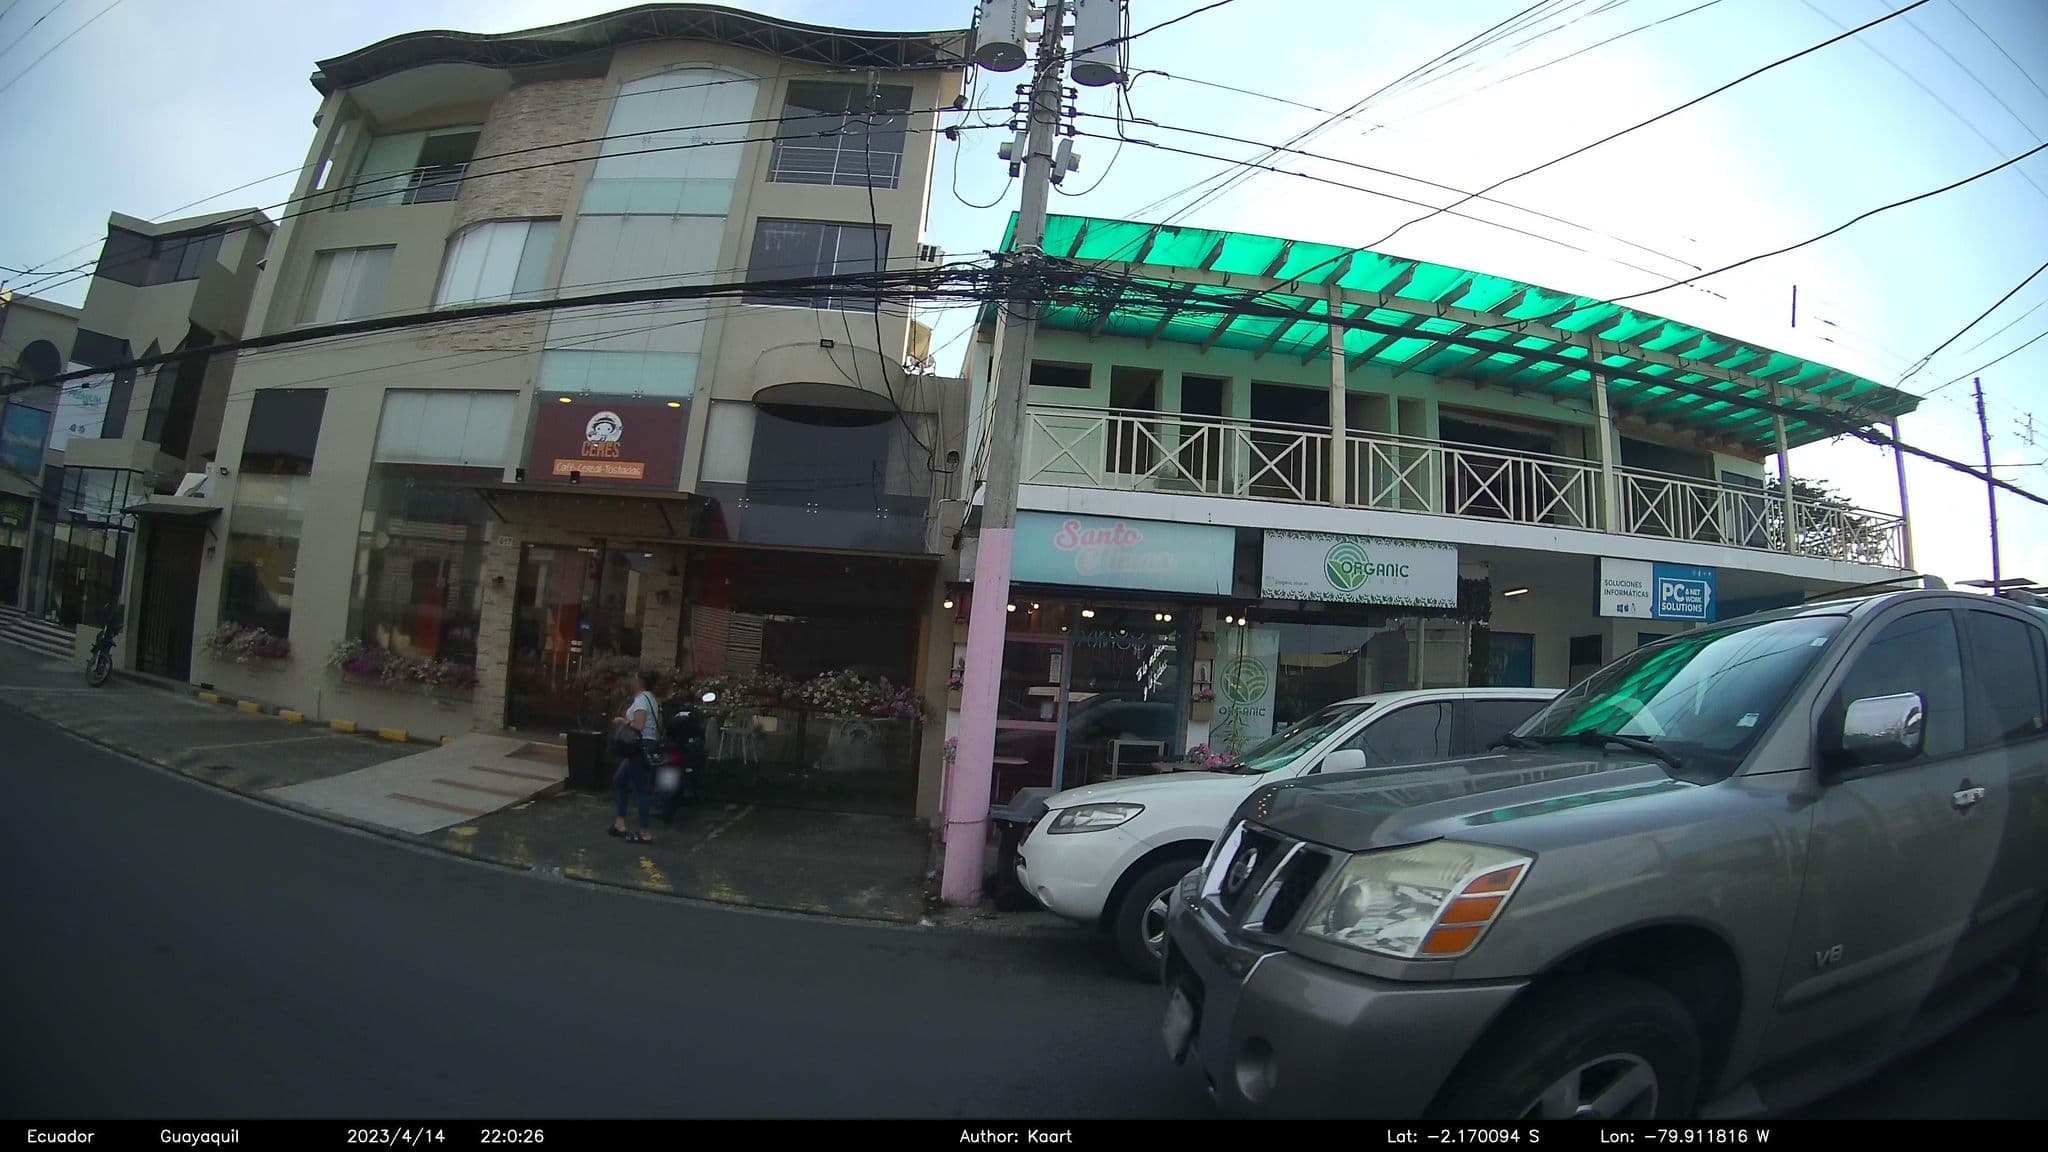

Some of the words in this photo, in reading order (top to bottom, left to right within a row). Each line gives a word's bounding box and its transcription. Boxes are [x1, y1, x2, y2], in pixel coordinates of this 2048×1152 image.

[581, 441, 621, 458] CERES
[1055, 519, 1142, 551] Santo
[1341, 561, 1409, 578] ORGANIC
[1604, 579, 1642, 588] SOLUCIONES
[1662, 582, 1685, 602] PC
[1661, 603, 1703, 613] SOLUTIONS
[1815, 944, 1843, 967] V8
